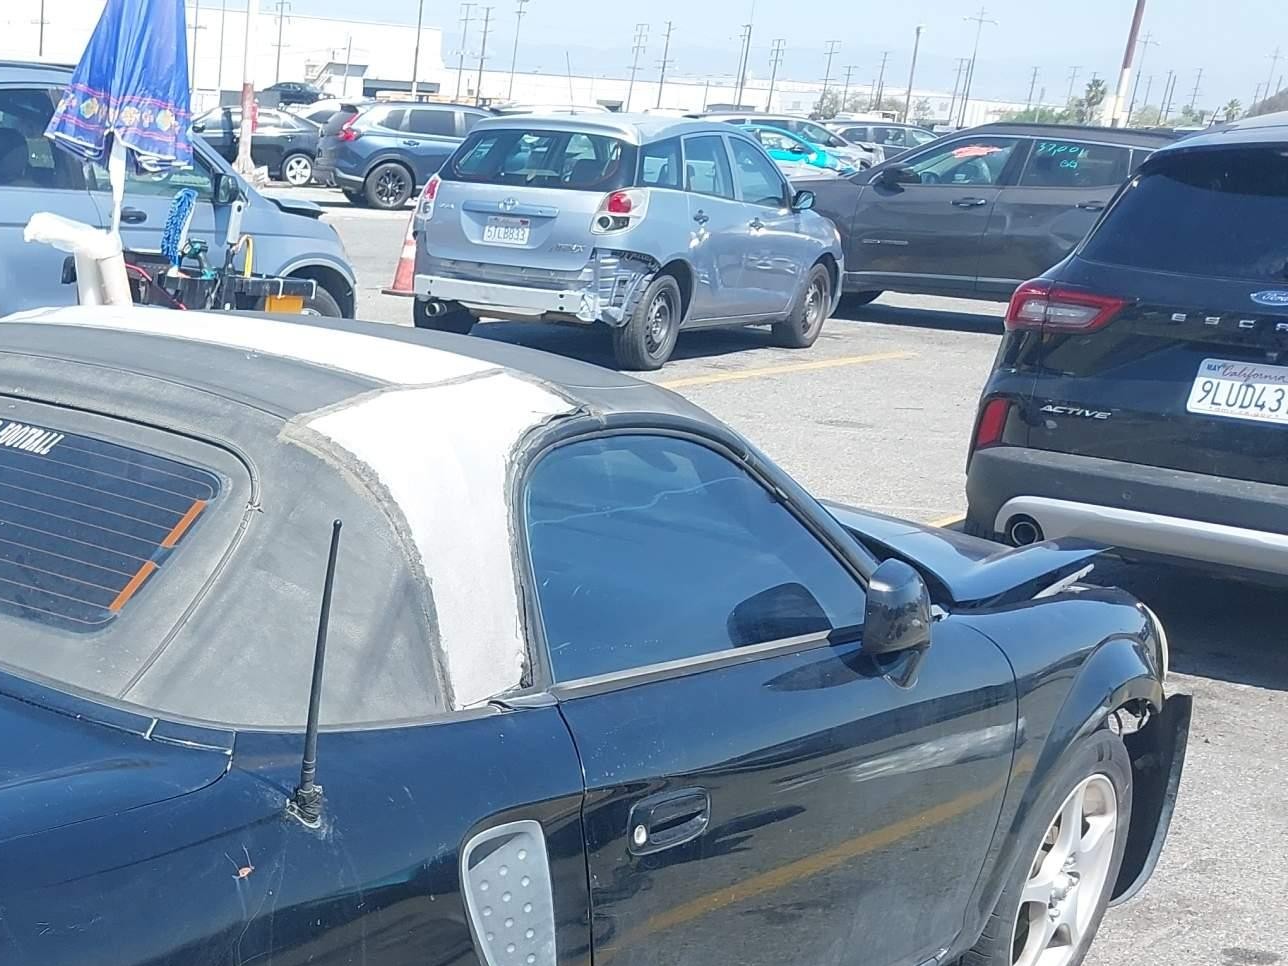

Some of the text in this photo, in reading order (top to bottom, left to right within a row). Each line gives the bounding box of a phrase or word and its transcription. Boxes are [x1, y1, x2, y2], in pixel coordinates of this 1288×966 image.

[1222, 365, 1286, 383] California
[1197, 380, 1288, 414] 9LUD43
[1039, 404, 1112, 419] ACTIVE
